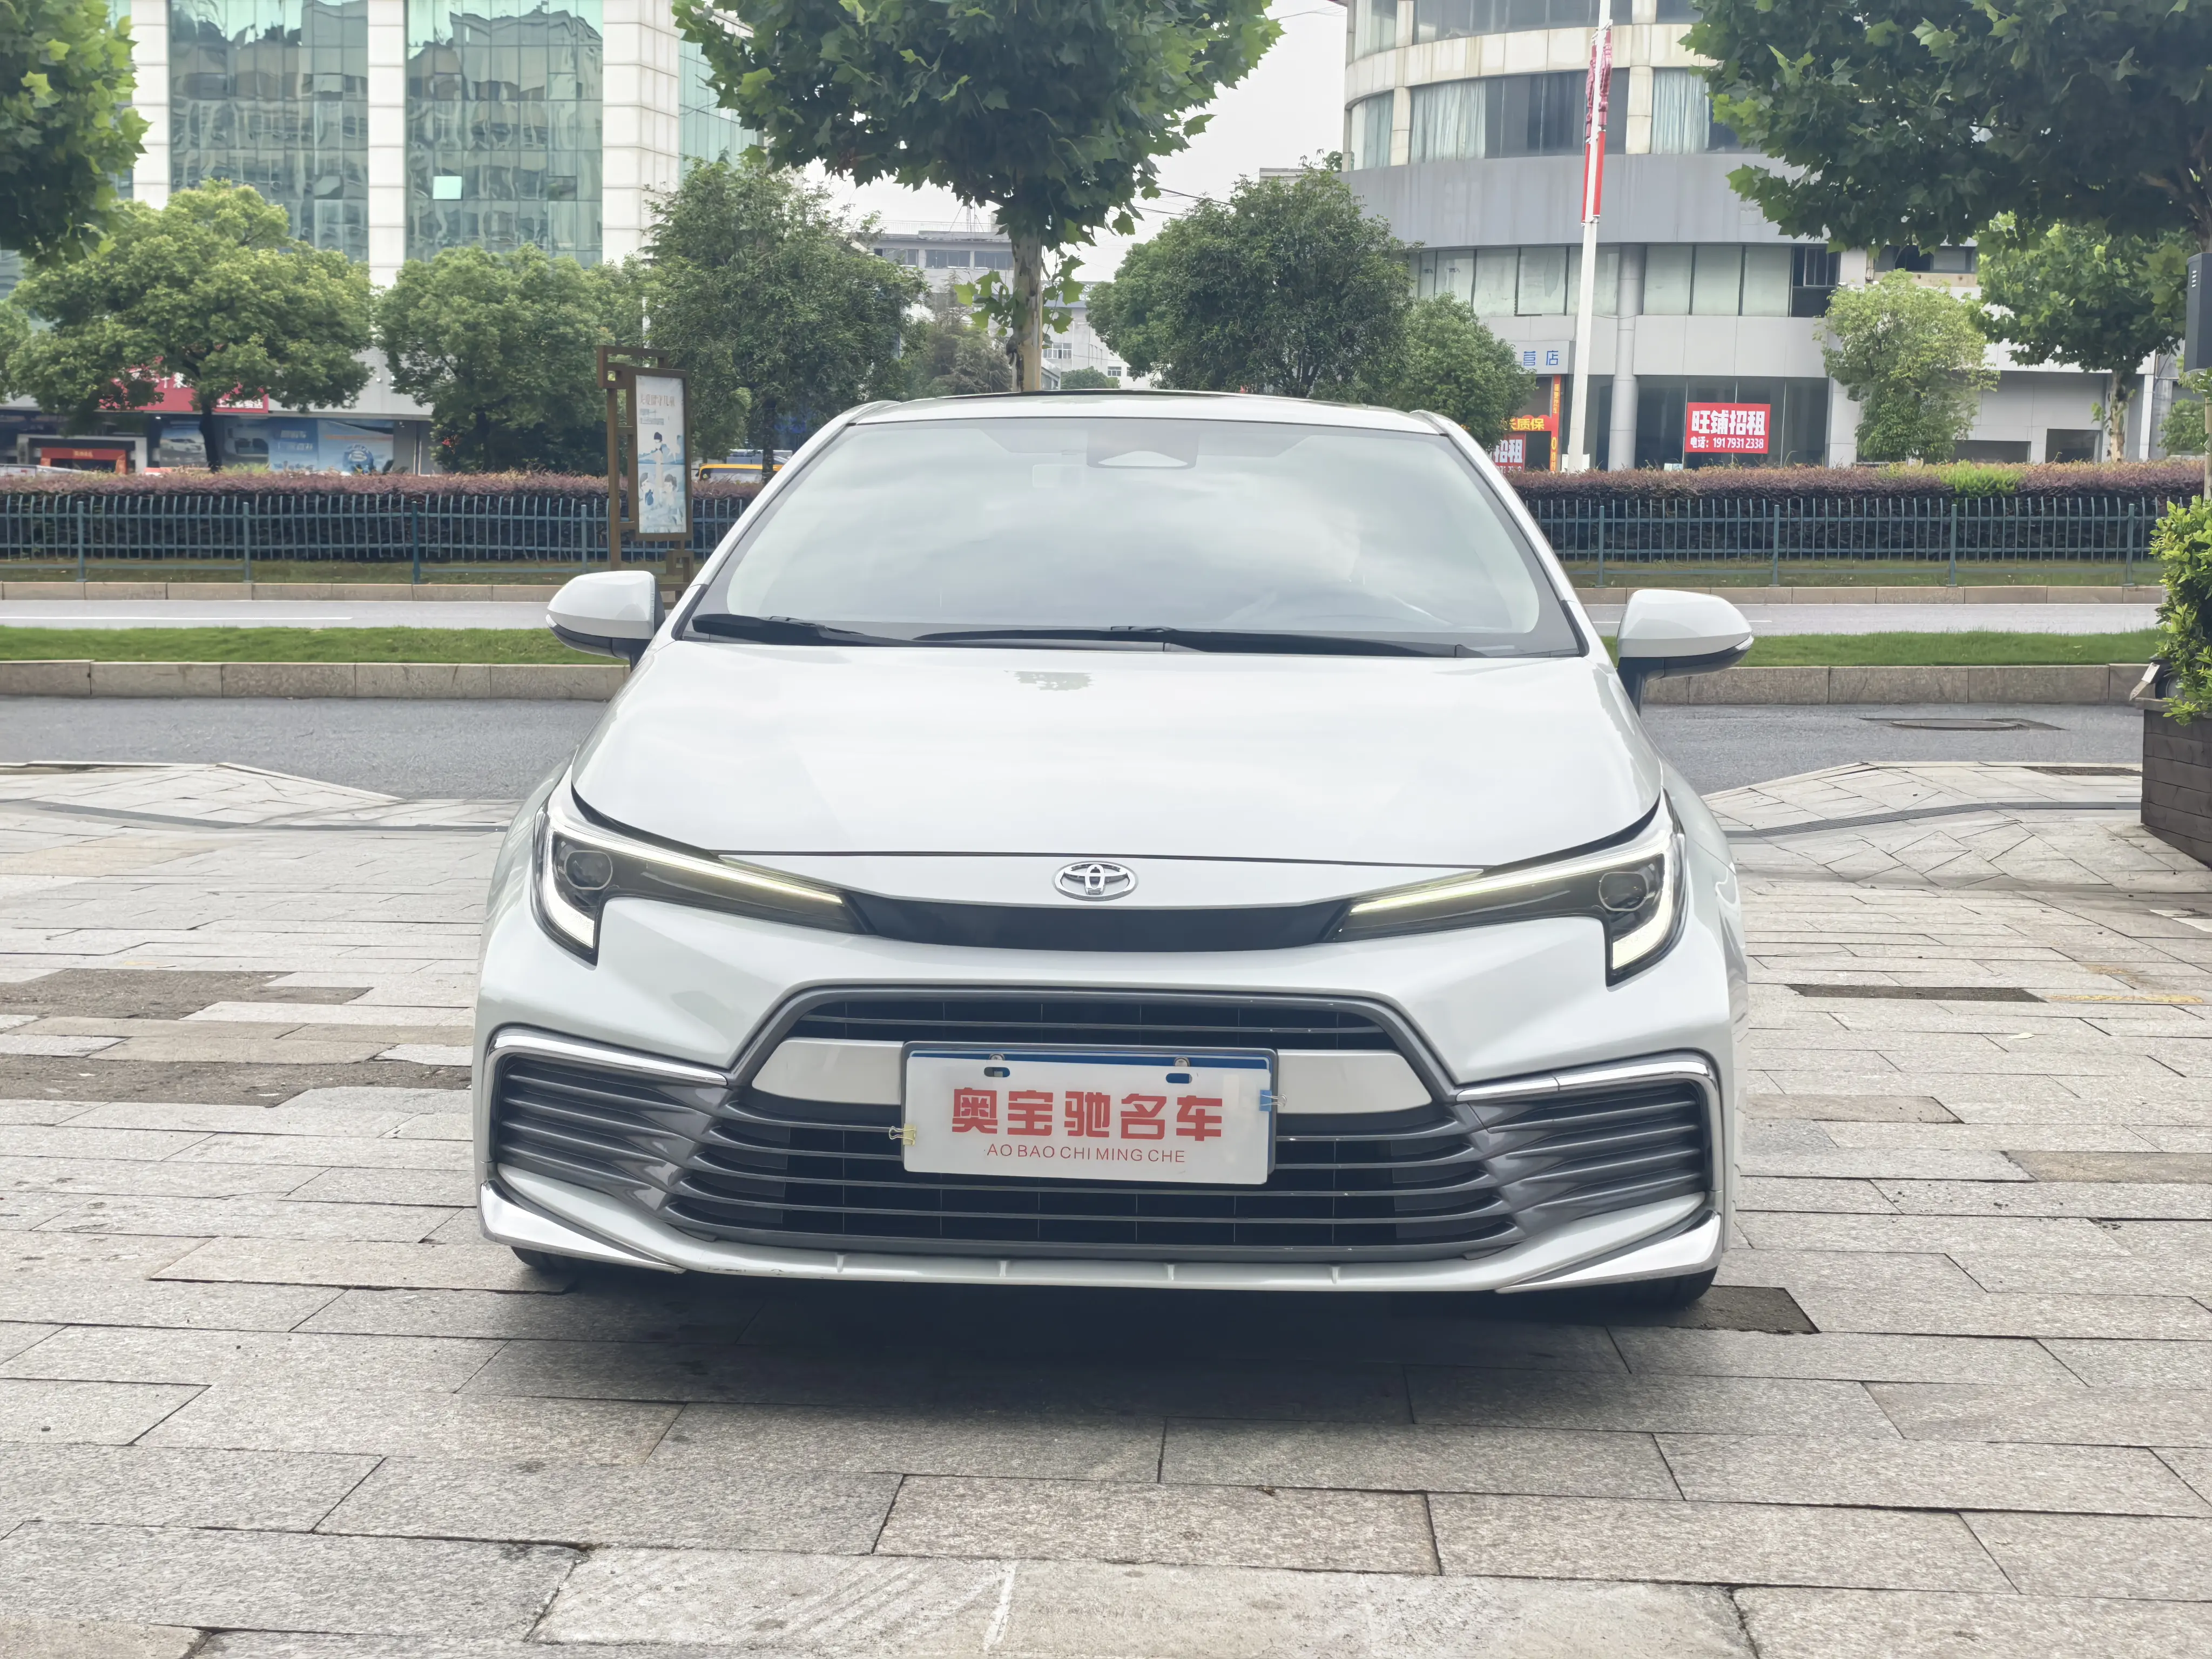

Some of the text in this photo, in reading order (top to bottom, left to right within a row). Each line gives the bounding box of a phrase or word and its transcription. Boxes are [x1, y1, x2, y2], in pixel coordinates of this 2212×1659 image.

[1514, 350, 1559, 366] 营店
[1691, 409, 1765, 436] 旺铺招租
[1490, 439, 1523, 463] 招租
[952, 1087, 1223, 1141] 奥宝驰名车
[987, 1143, 1186, 1163] AO BAO CHI MING CHE
